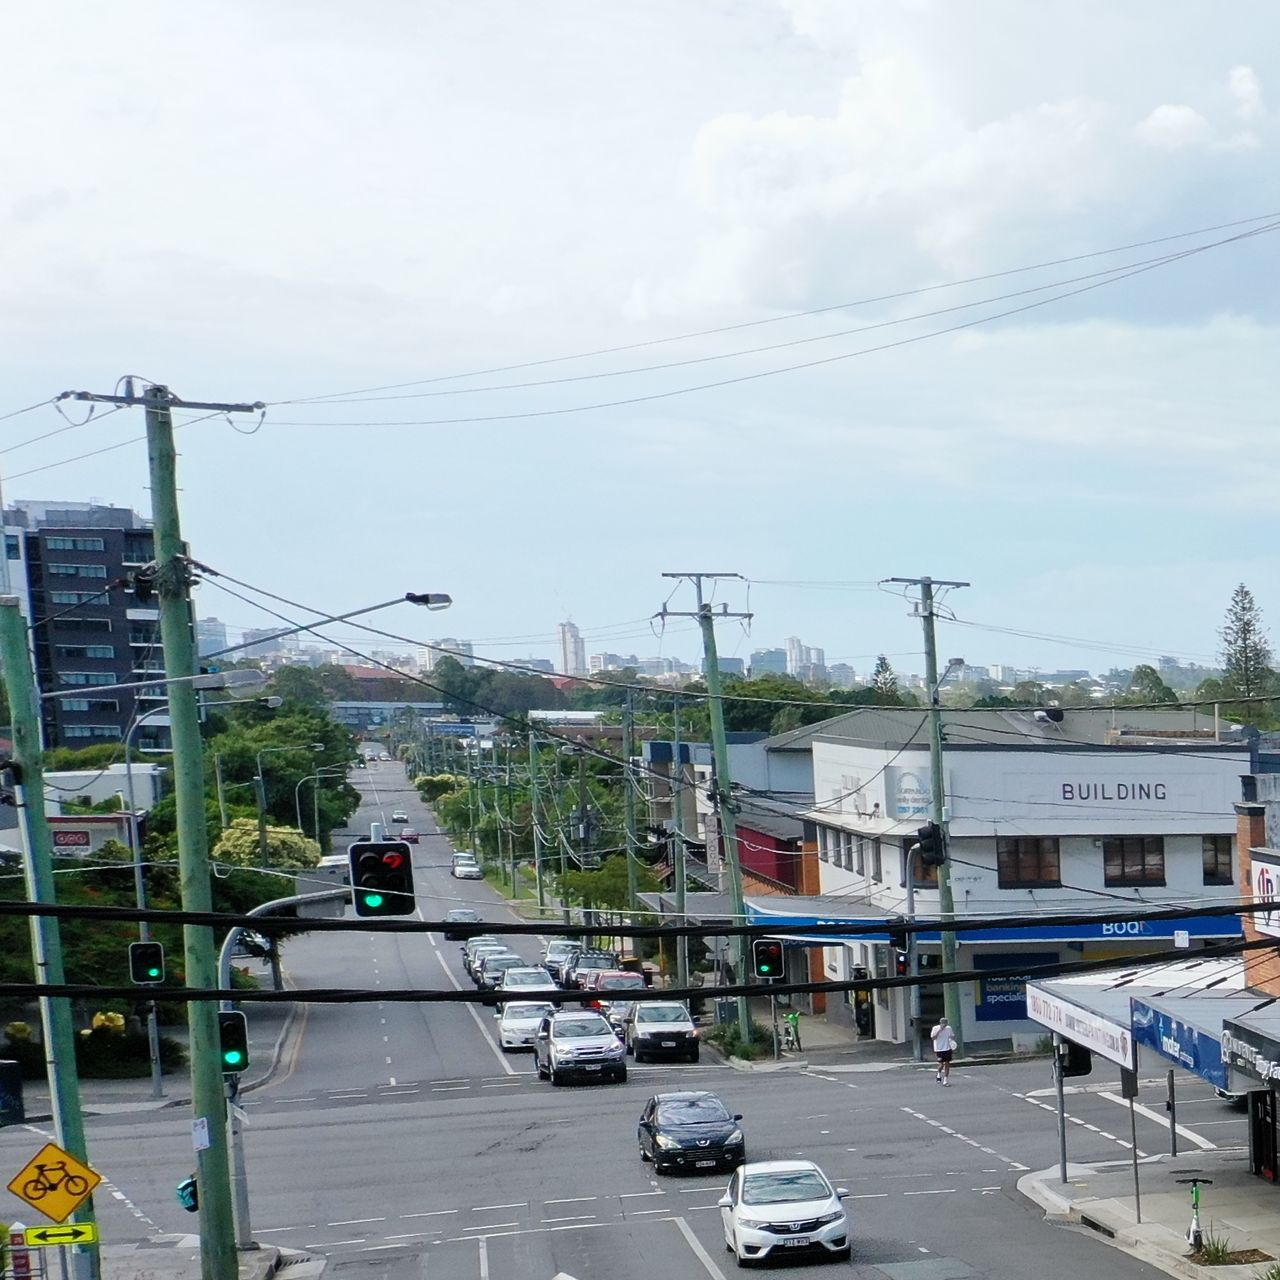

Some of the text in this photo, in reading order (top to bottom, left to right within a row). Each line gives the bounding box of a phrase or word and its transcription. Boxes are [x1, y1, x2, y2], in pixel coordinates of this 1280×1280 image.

[1062, 783, 1167, 801] BUILDING
[1102, 921, 1139, 935] BOQ
[986, 991, 1027, 1004] specialis
